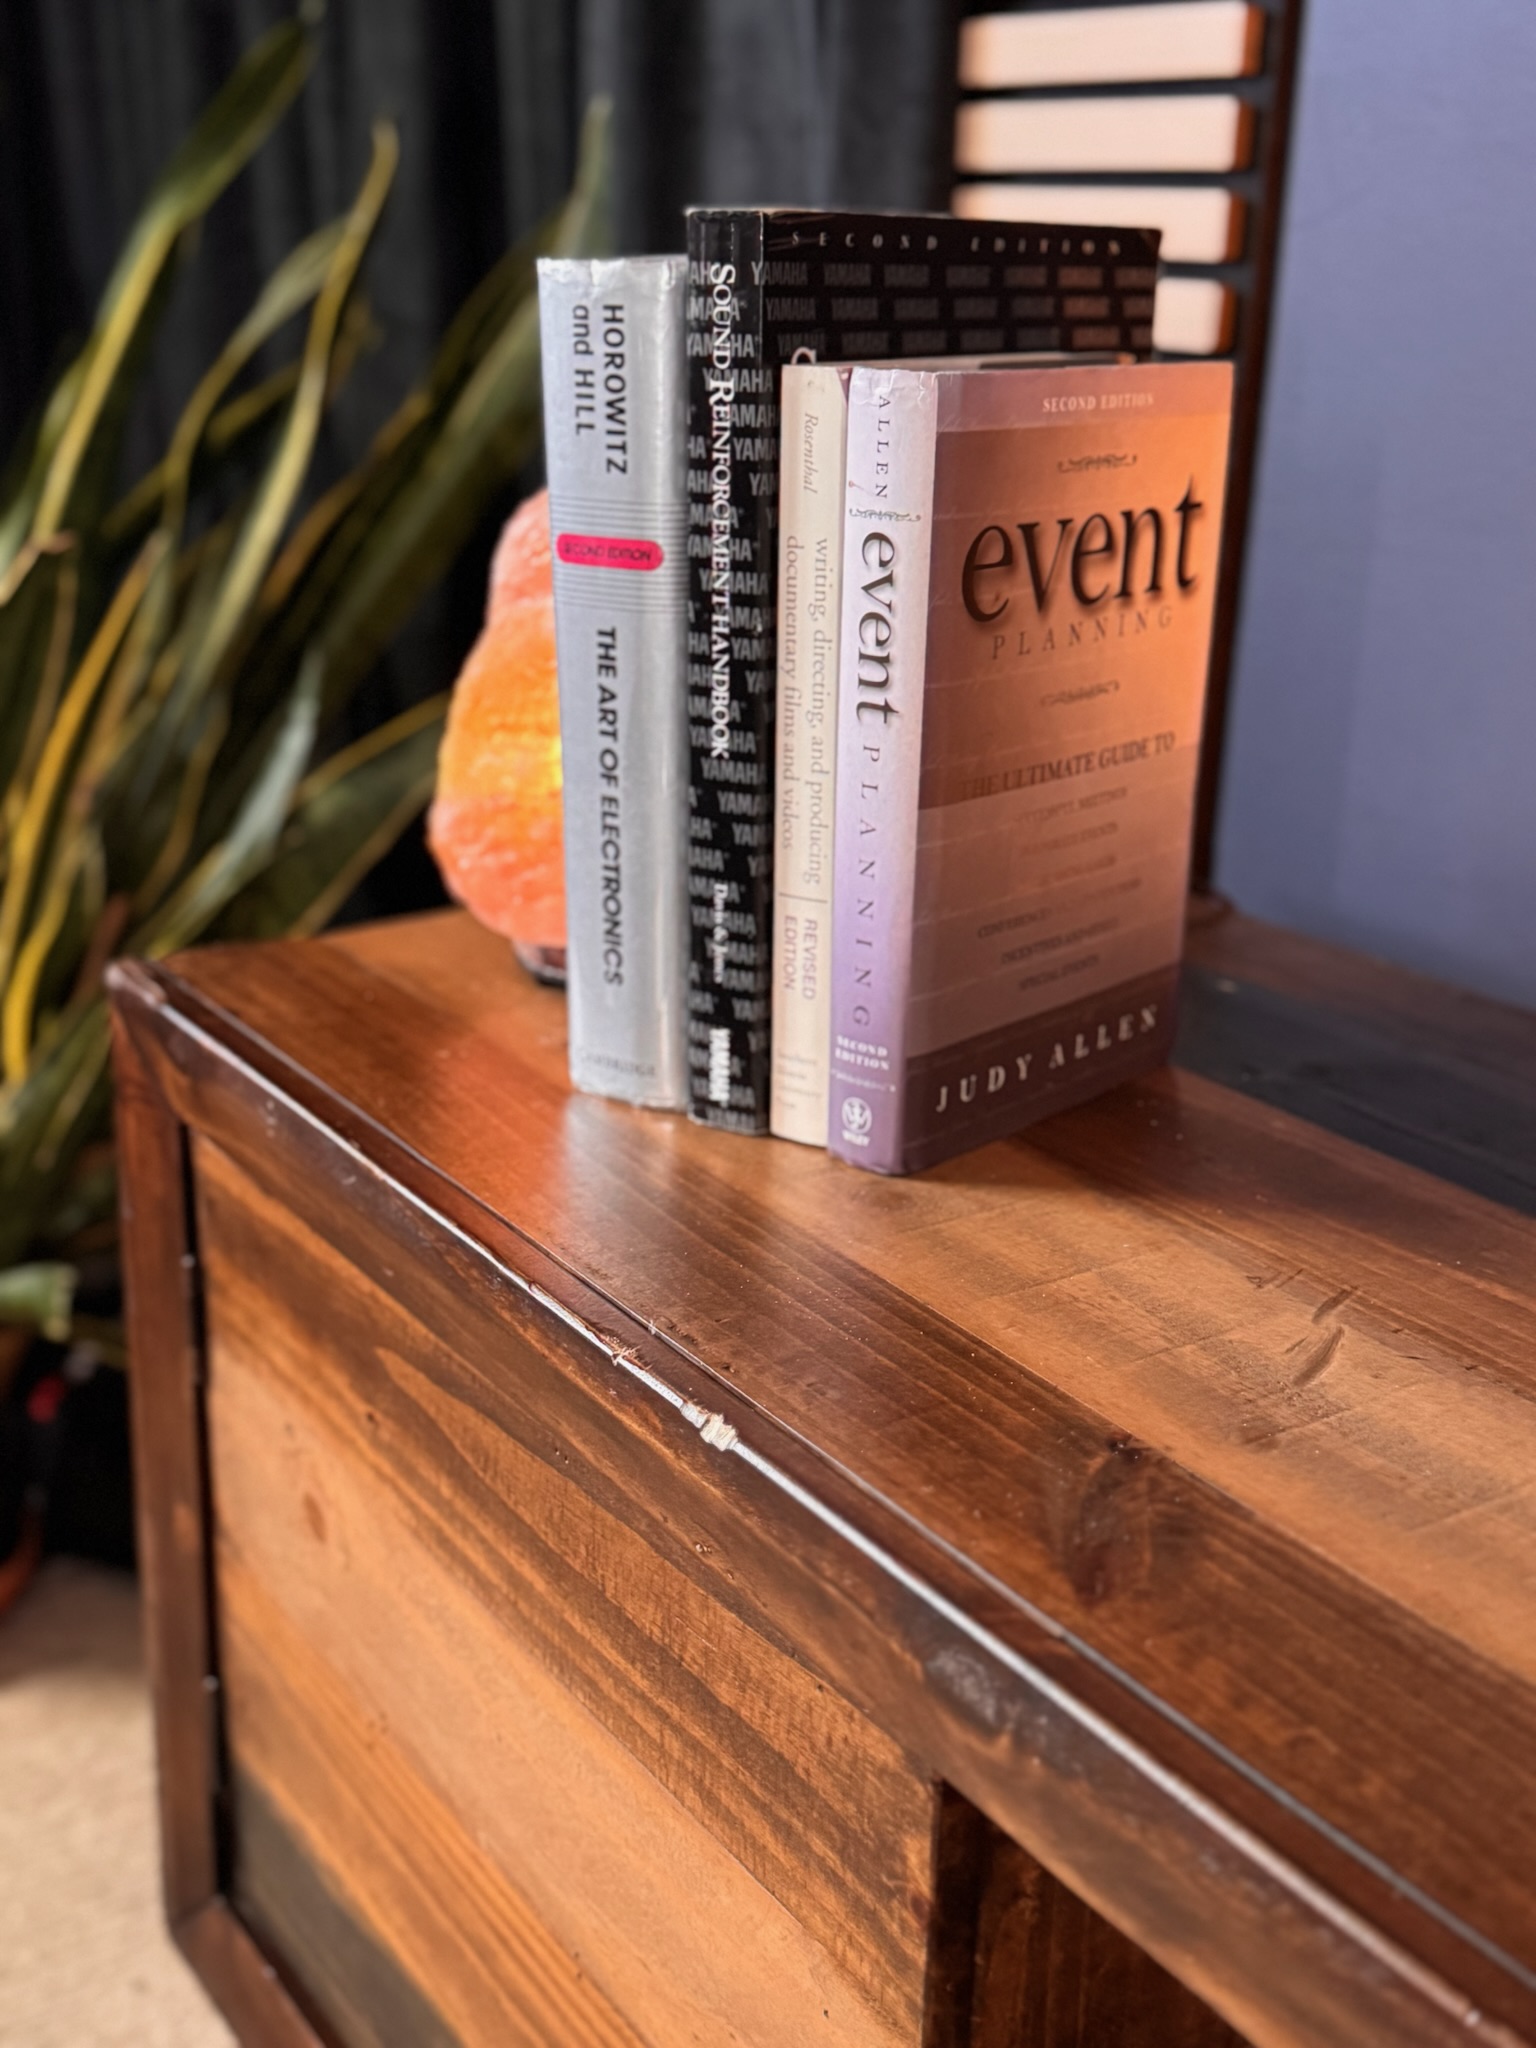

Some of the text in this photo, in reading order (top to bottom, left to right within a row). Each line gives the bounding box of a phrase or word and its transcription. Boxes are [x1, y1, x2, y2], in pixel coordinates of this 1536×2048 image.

[792, 231, 939, 252] SECOND
[572, 304, 596, 435] and HILL
[710, 263, 736, 370] SOUND
[602, 303, 628, 474] HOROWITZ
[1043, 392, 1154, 413] SECOND EDITION
[708, 378, 735, 610] REINFORCEMENT
[803, 412, 819, 495] Rosenthal
[875, 395, 892, 498] ALLEN
[961, 473, 1203, 624] event
[711, 612, 731, 759] HANDBOOK
[992, 606, 1174, 660] PLANNING
[780, 535, 805, 850] documentary films and videos
[802, 537, 834, 885] writing, directing, and producing
[596, 626, 624, 986] THE ART OF ELECTRONICS
[852, 531, 900, 1028] event PLANNING
[1002, 751, 1097, 791] ULTIMATE
[1099, 740, 1146, 769] GUIDE
[1150, 731, 1175, 757] TO
[783, 915, 798, 991] EDITION
[801, 918, 818, 1000] REVISED
[935, 1003, 1158, 1113] JUDY ALLEN
